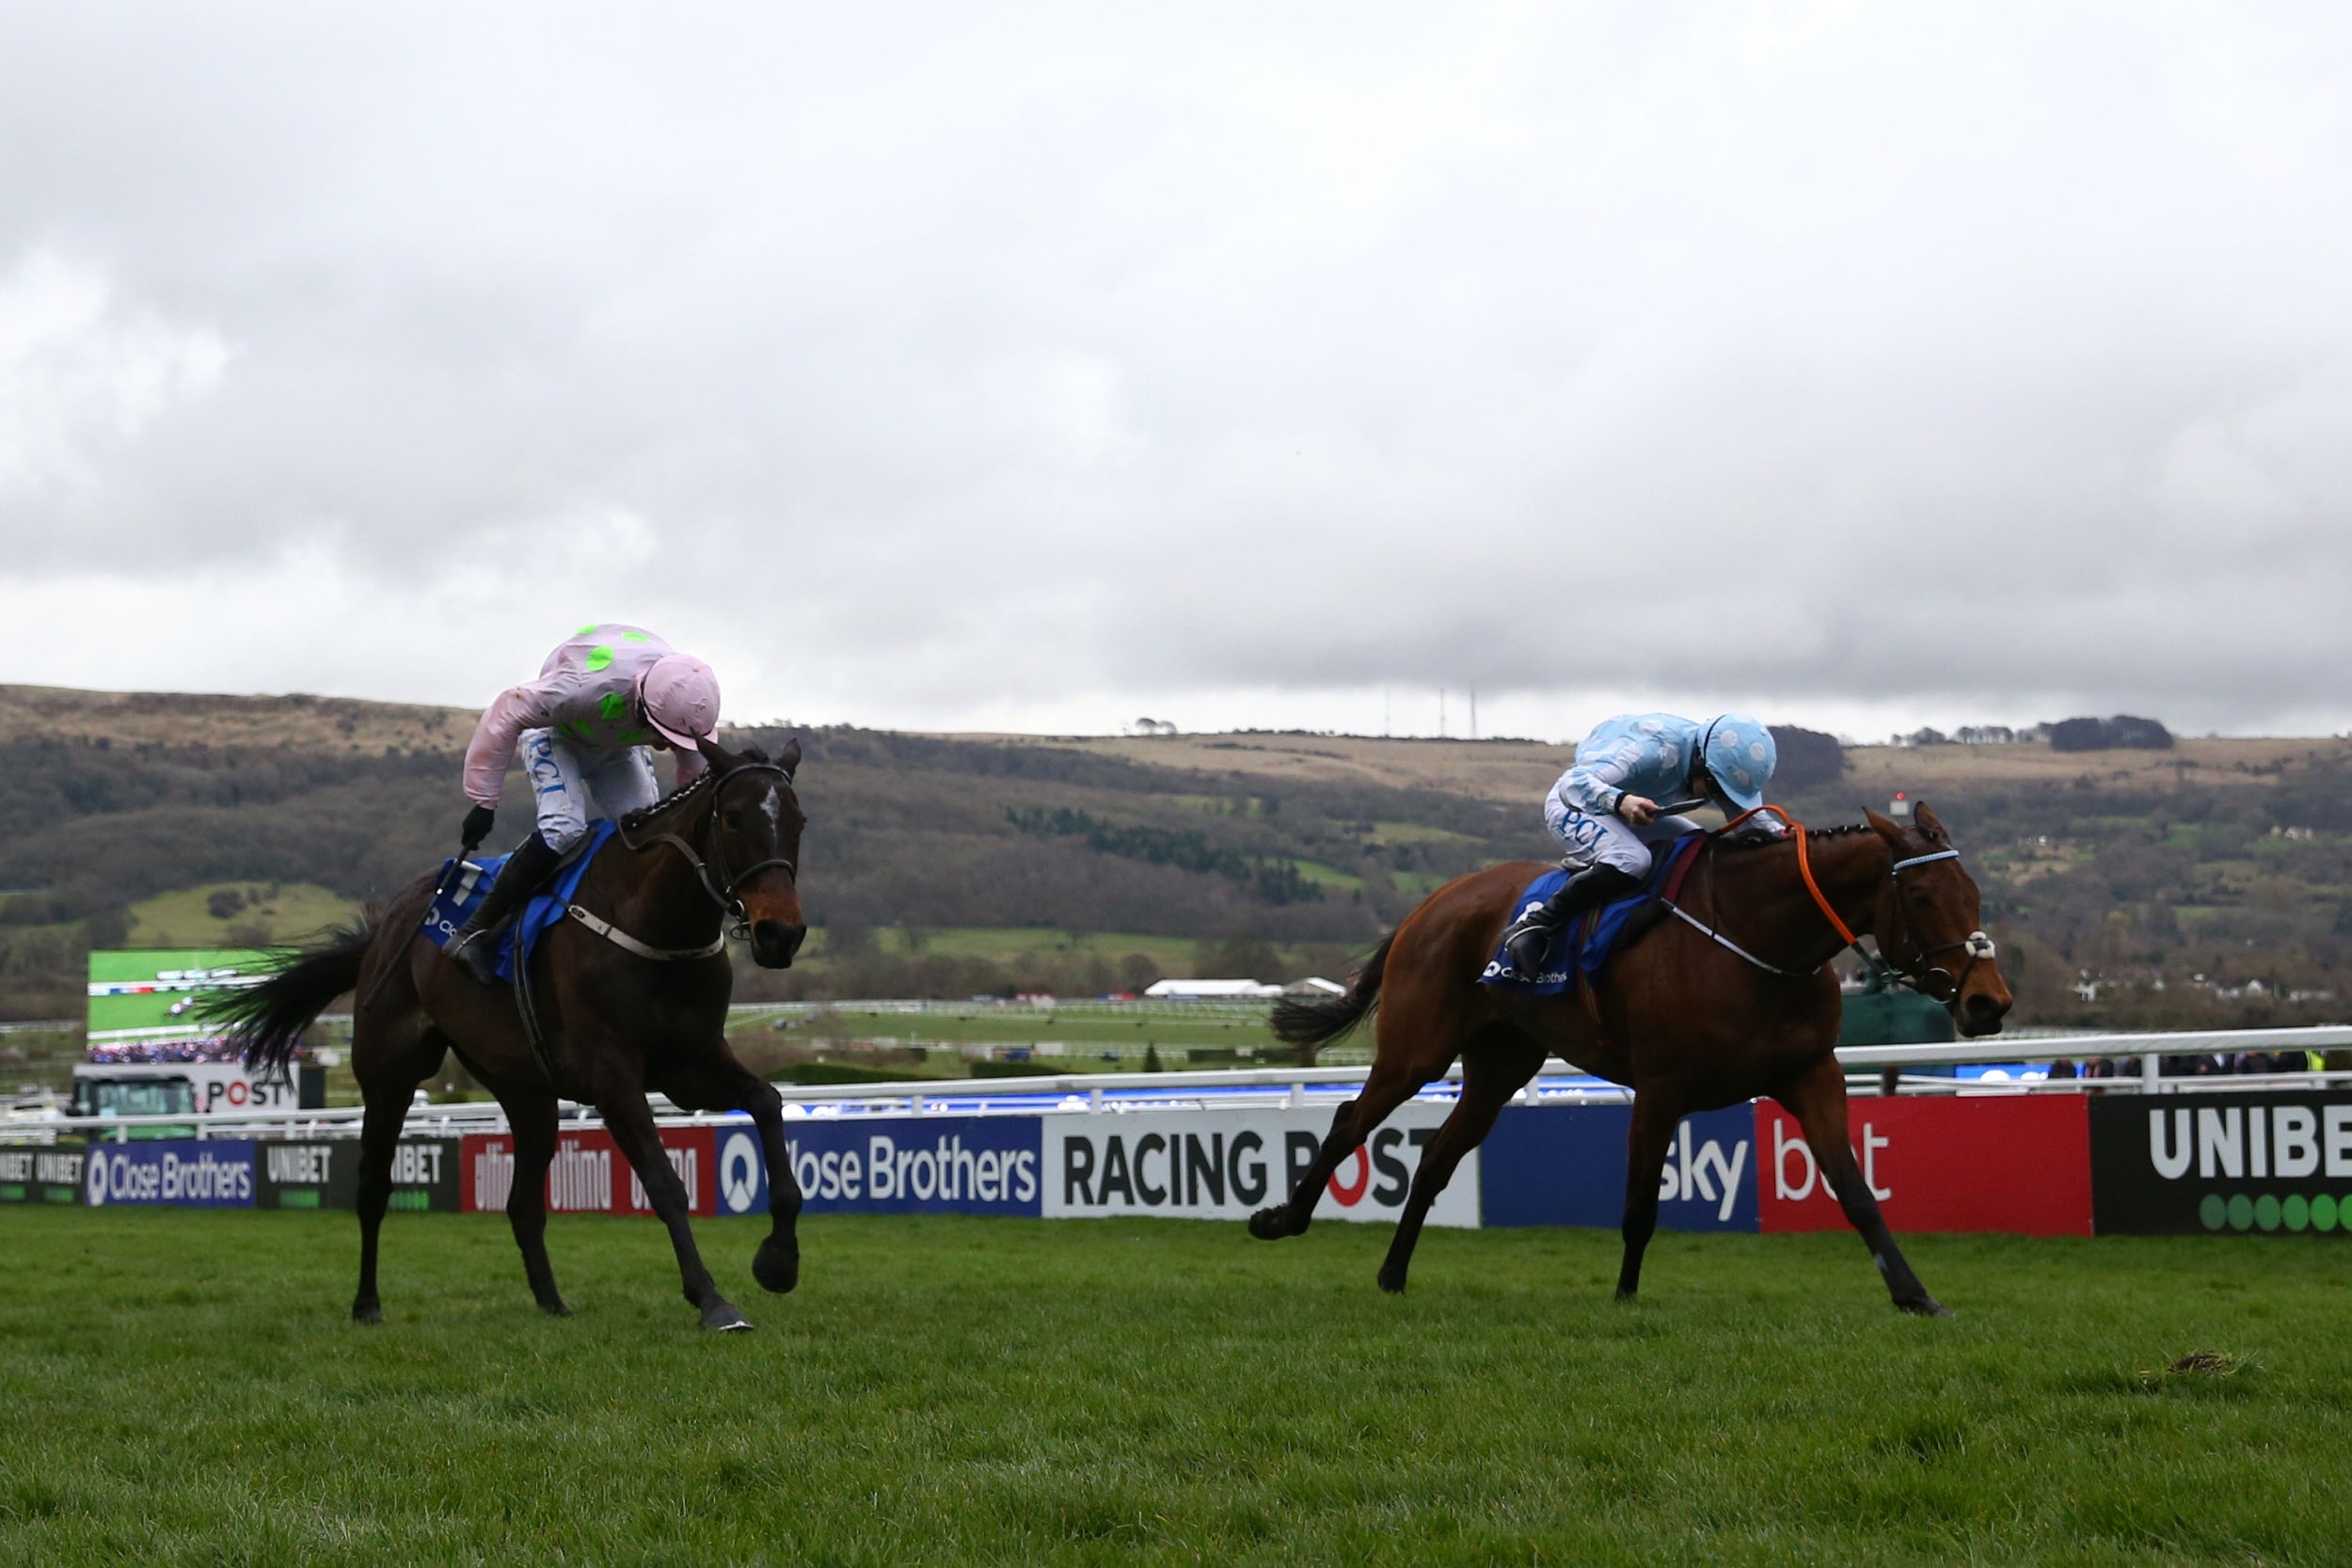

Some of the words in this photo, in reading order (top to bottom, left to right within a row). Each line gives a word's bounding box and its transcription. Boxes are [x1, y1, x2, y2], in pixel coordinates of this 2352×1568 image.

[530, 735, 567, 800] PCI
[1559, 810, 1609, 853] PCI
[208, 1081, 287, 1107] POST
[36, 1153, 85, 1184] UNIBET
[109, 1153, 160, 1200] Close
[161, 1151, 252, 1200] Brothers
[266, 1146, 333, 1184] UNIBET
[549, 1139, 612, 1211] ultima
[784, 1137, 863, 1201] lose
[868, 1134, 1037, 1203] Brothers
[1064, 1130, 1268, 1208] RACING
[1658, 1119, 1749, 1222] sky
[1773, 1117, 1893, 1202] bt
